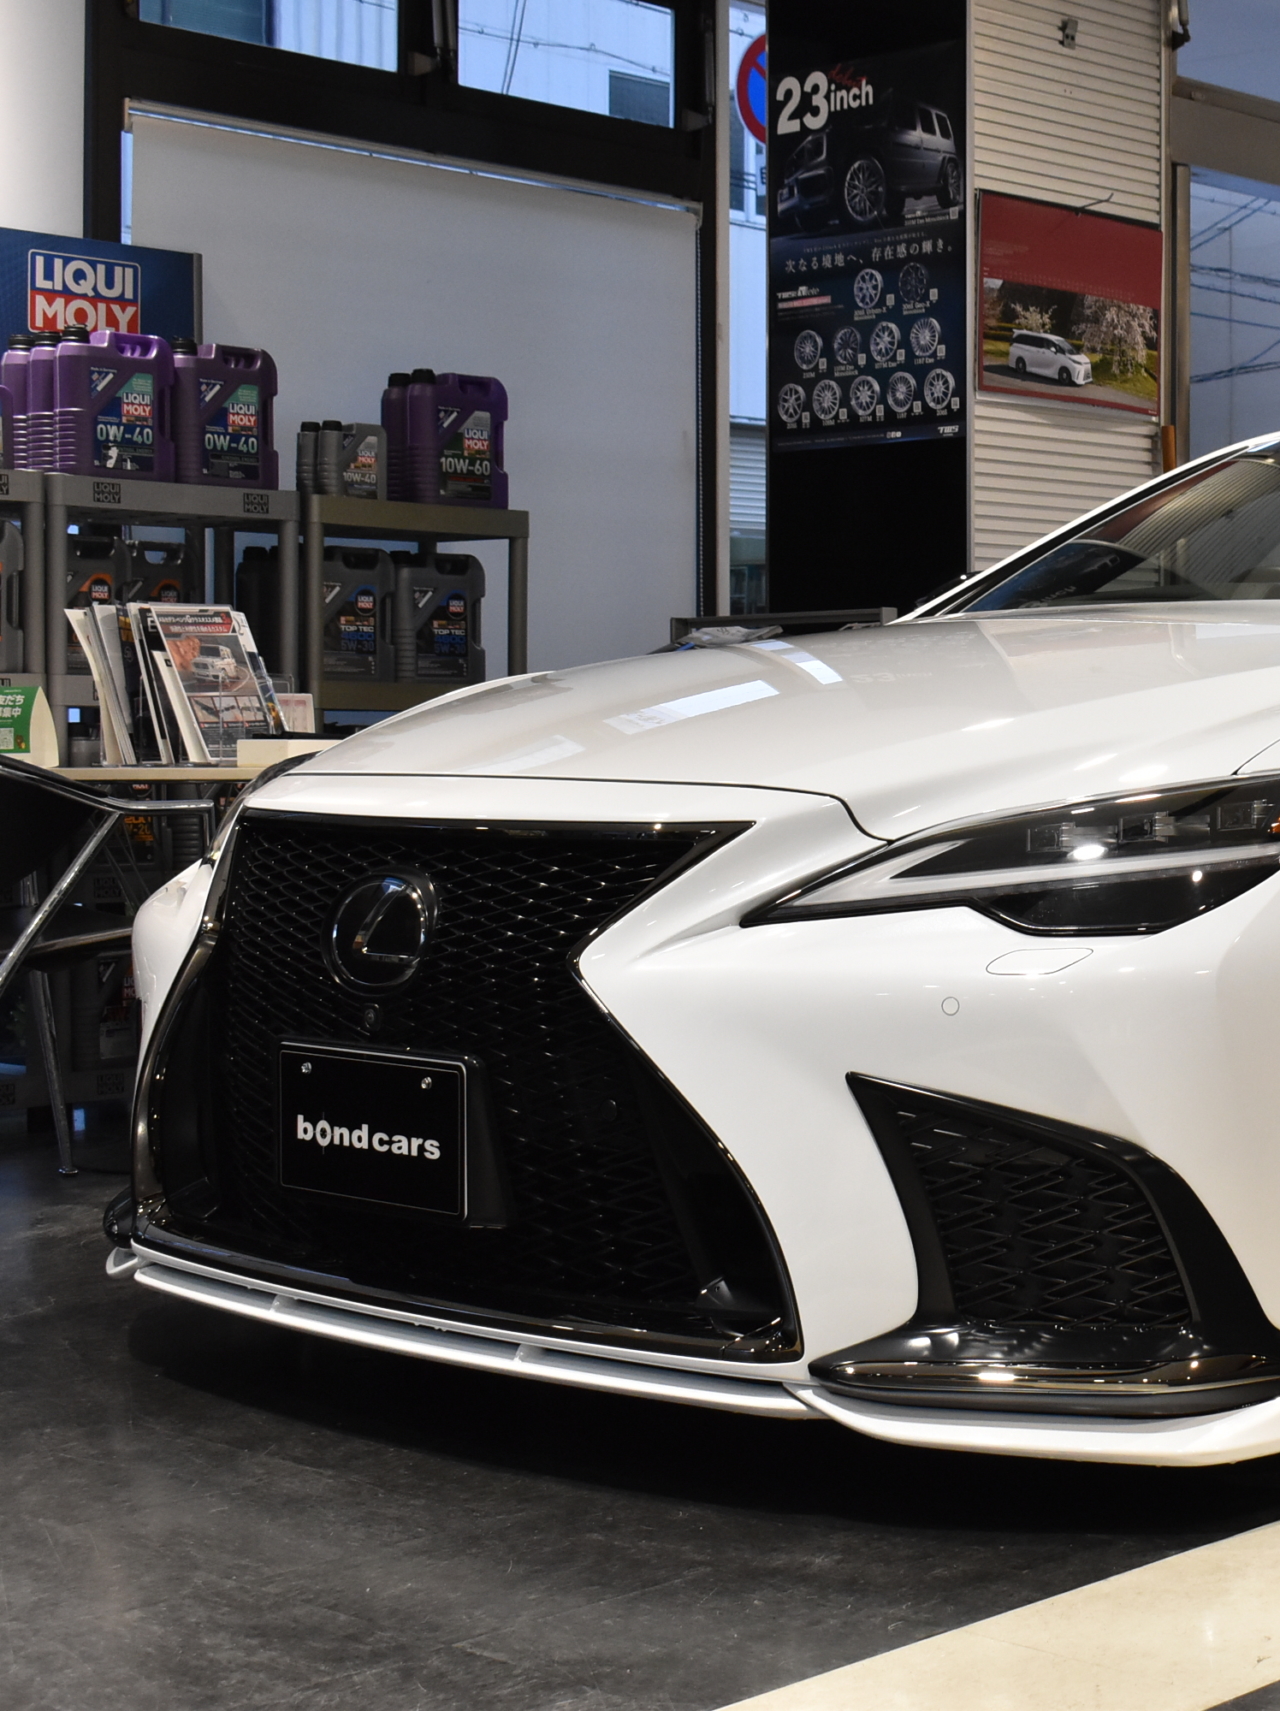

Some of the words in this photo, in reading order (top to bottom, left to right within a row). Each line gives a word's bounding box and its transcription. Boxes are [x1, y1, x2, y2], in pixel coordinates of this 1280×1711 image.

[35, 255, 133, 299] LIQUI
[35, 295, 137, 334] MOLY
[123, 392, 151, 405] LIQUI
[123, 404, 151, 416] MOLY
[229, 403, 255, 415] LIQUI
[229, 414, 257, 426] MOLY
[97, 424, 153, 444] 0W-40
[465, 428, 489, 439] LIQUI
[205, 433, 258, 454] 0W-40
[465, 439, 489, 450] MOLY
[440, 457, 490, 476] 10W-60
[343, 472, 376, 484] 10W-40
[94, 483, 120, 492] LIQUI
[94, 492, 121, 503] MOLY
[244, 493, 268, 504] LIQUI
[244, 503, 269, 513] MOLY
